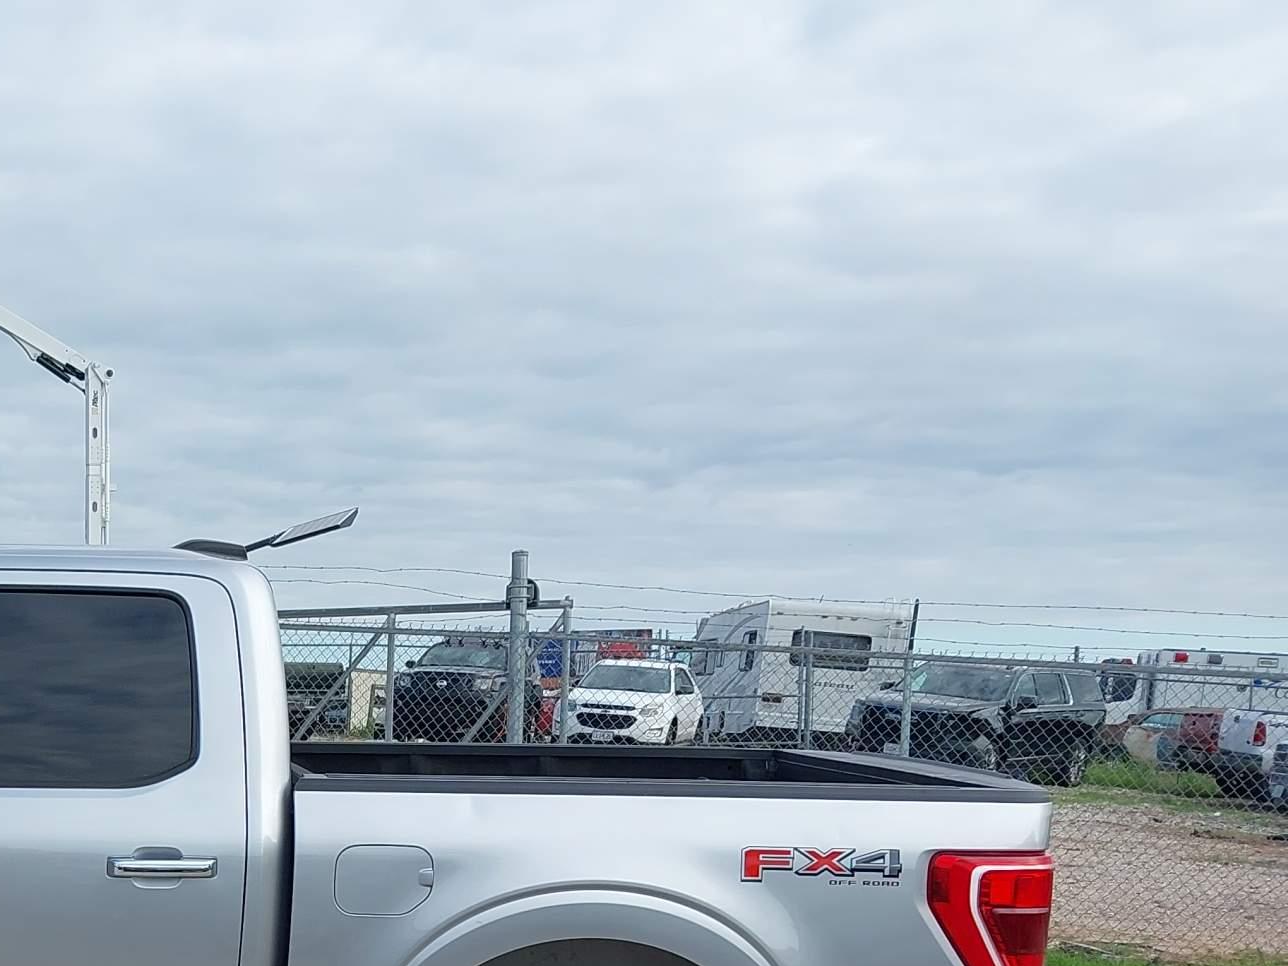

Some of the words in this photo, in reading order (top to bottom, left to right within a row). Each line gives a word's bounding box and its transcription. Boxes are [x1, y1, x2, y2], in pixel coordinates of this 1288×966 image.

[740, 845, 903, 883] FX4
[828, 879, 857, 887] OFF
[862, 880, 900, 888] ROAD
